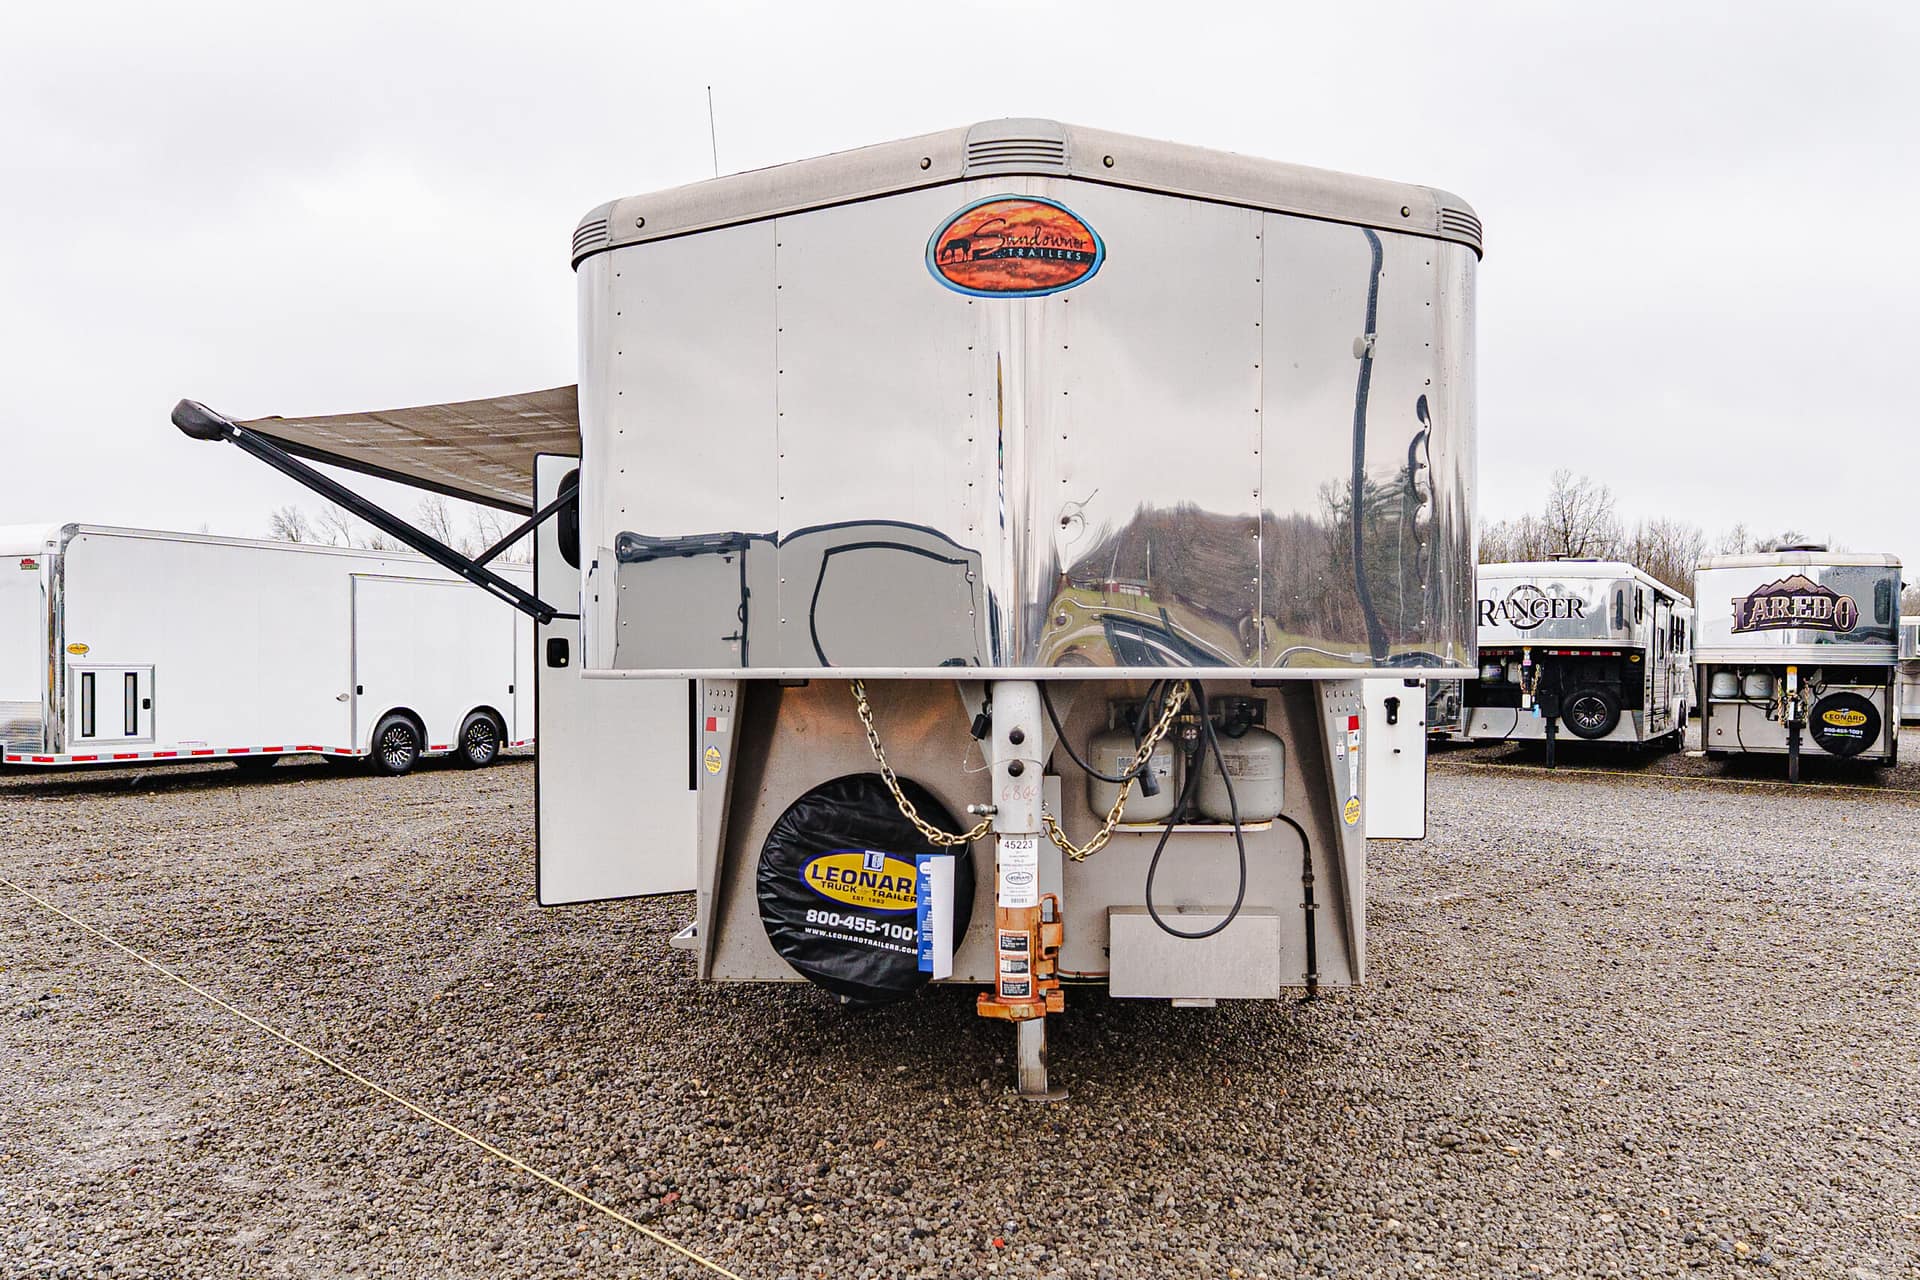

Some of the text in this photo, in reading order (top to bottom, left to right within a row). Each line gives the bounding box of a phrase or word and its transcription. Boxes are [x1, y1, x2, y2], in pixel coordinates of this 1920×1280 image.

[1008, 249, 1081, 261] TRAILERS
[1478, 598, 1585, 627] RANGER
[1731, 594, 1859, 634] LAREDO
[1824, 713, 1865, 722] LEONARD
[1004, 840, 1033, 849] 45223
[821, 881, 857, 893] TRUCK
